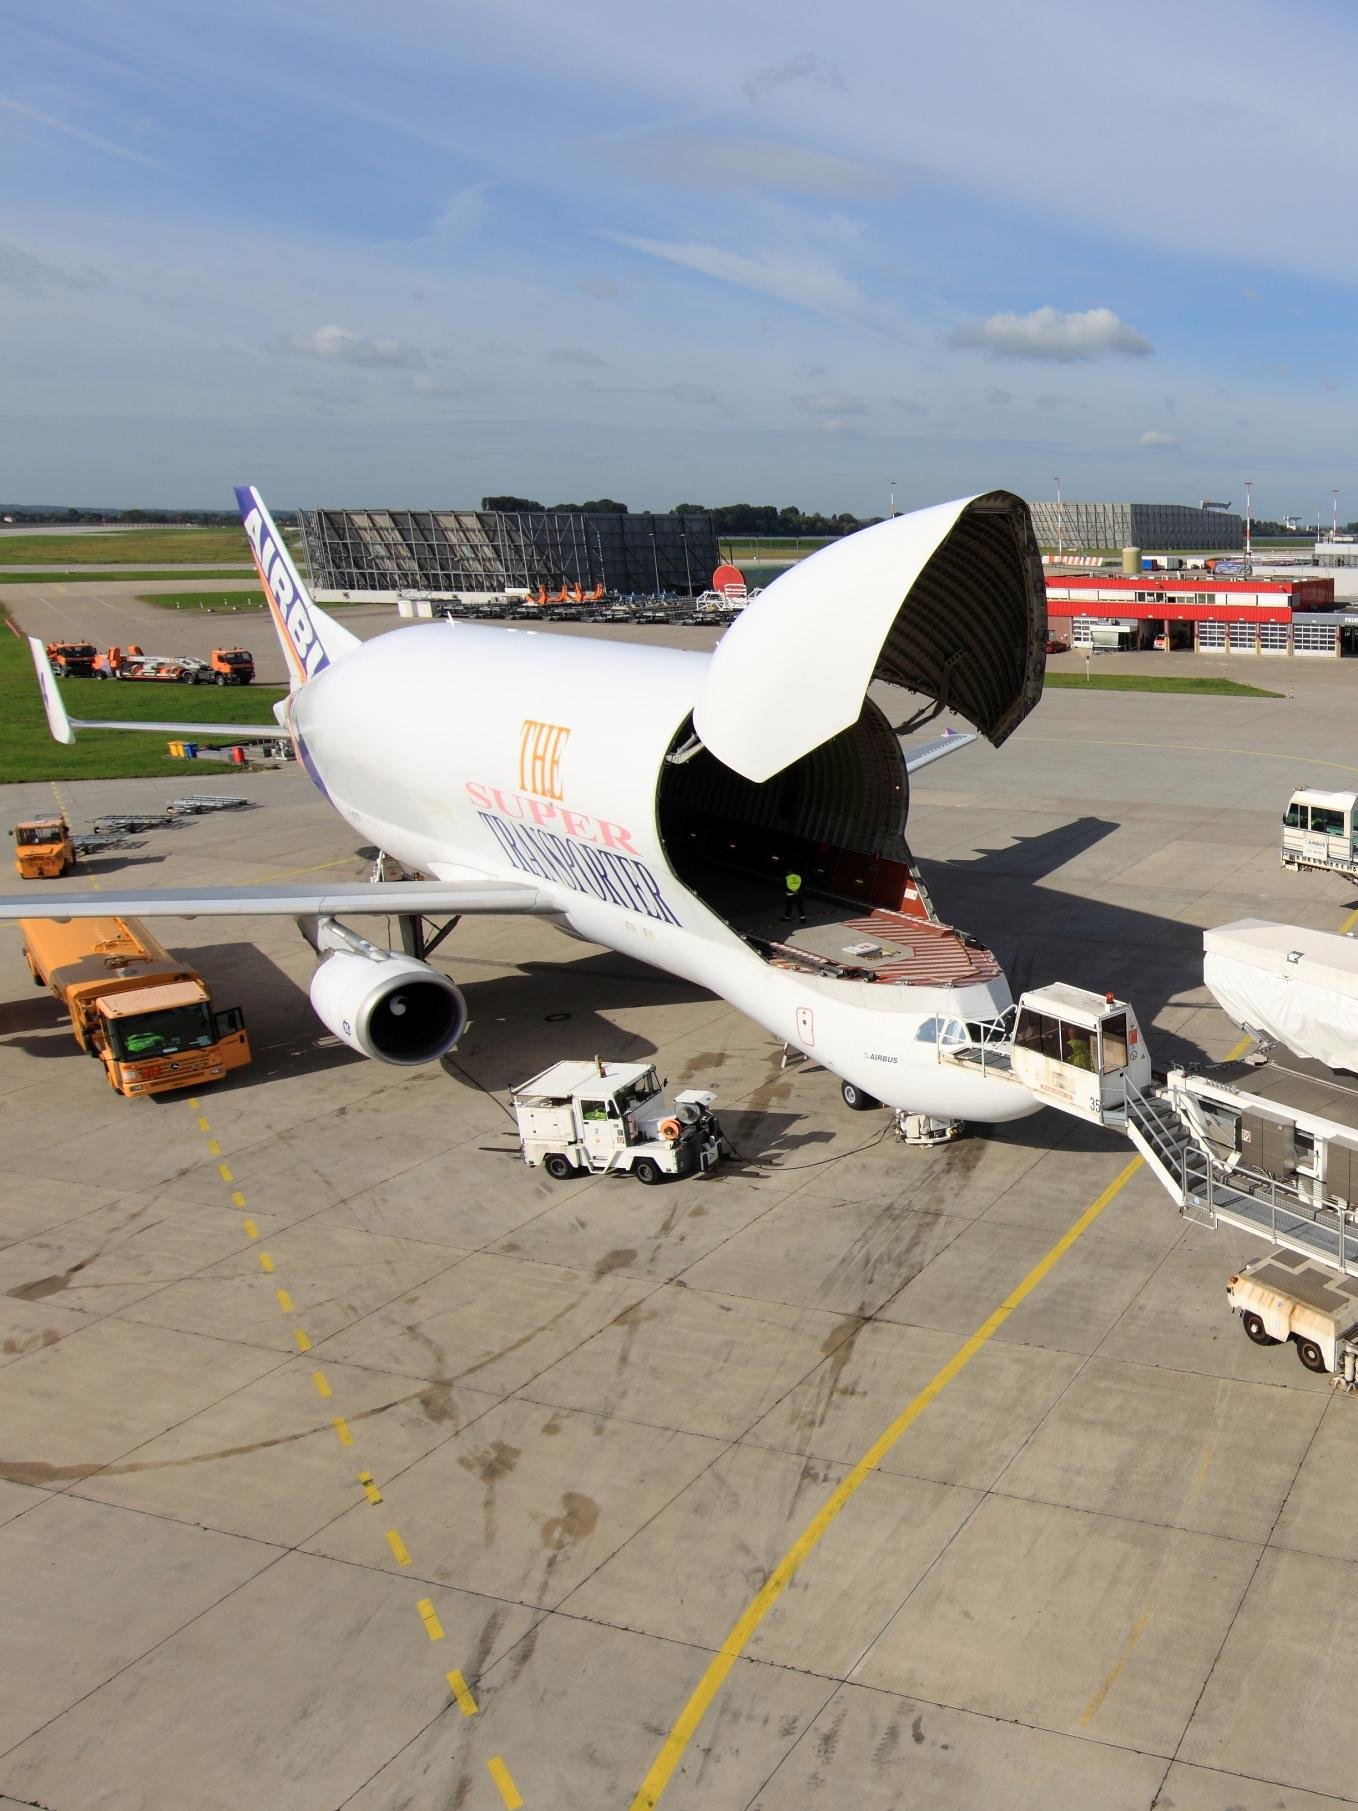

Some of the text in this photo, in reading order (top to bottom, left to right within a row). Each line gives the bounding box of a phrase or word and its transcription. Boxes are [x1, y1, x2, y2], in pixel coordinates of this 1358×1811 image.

[518, 720, 571, 801] THE
[464, 781, 642, 857] SUPER
[477, 810, 683, 928] TRANSPORTER
[870, 1053, 898, 1064] AIRBUS
[1090, 1097, 1101, 1112] 35
